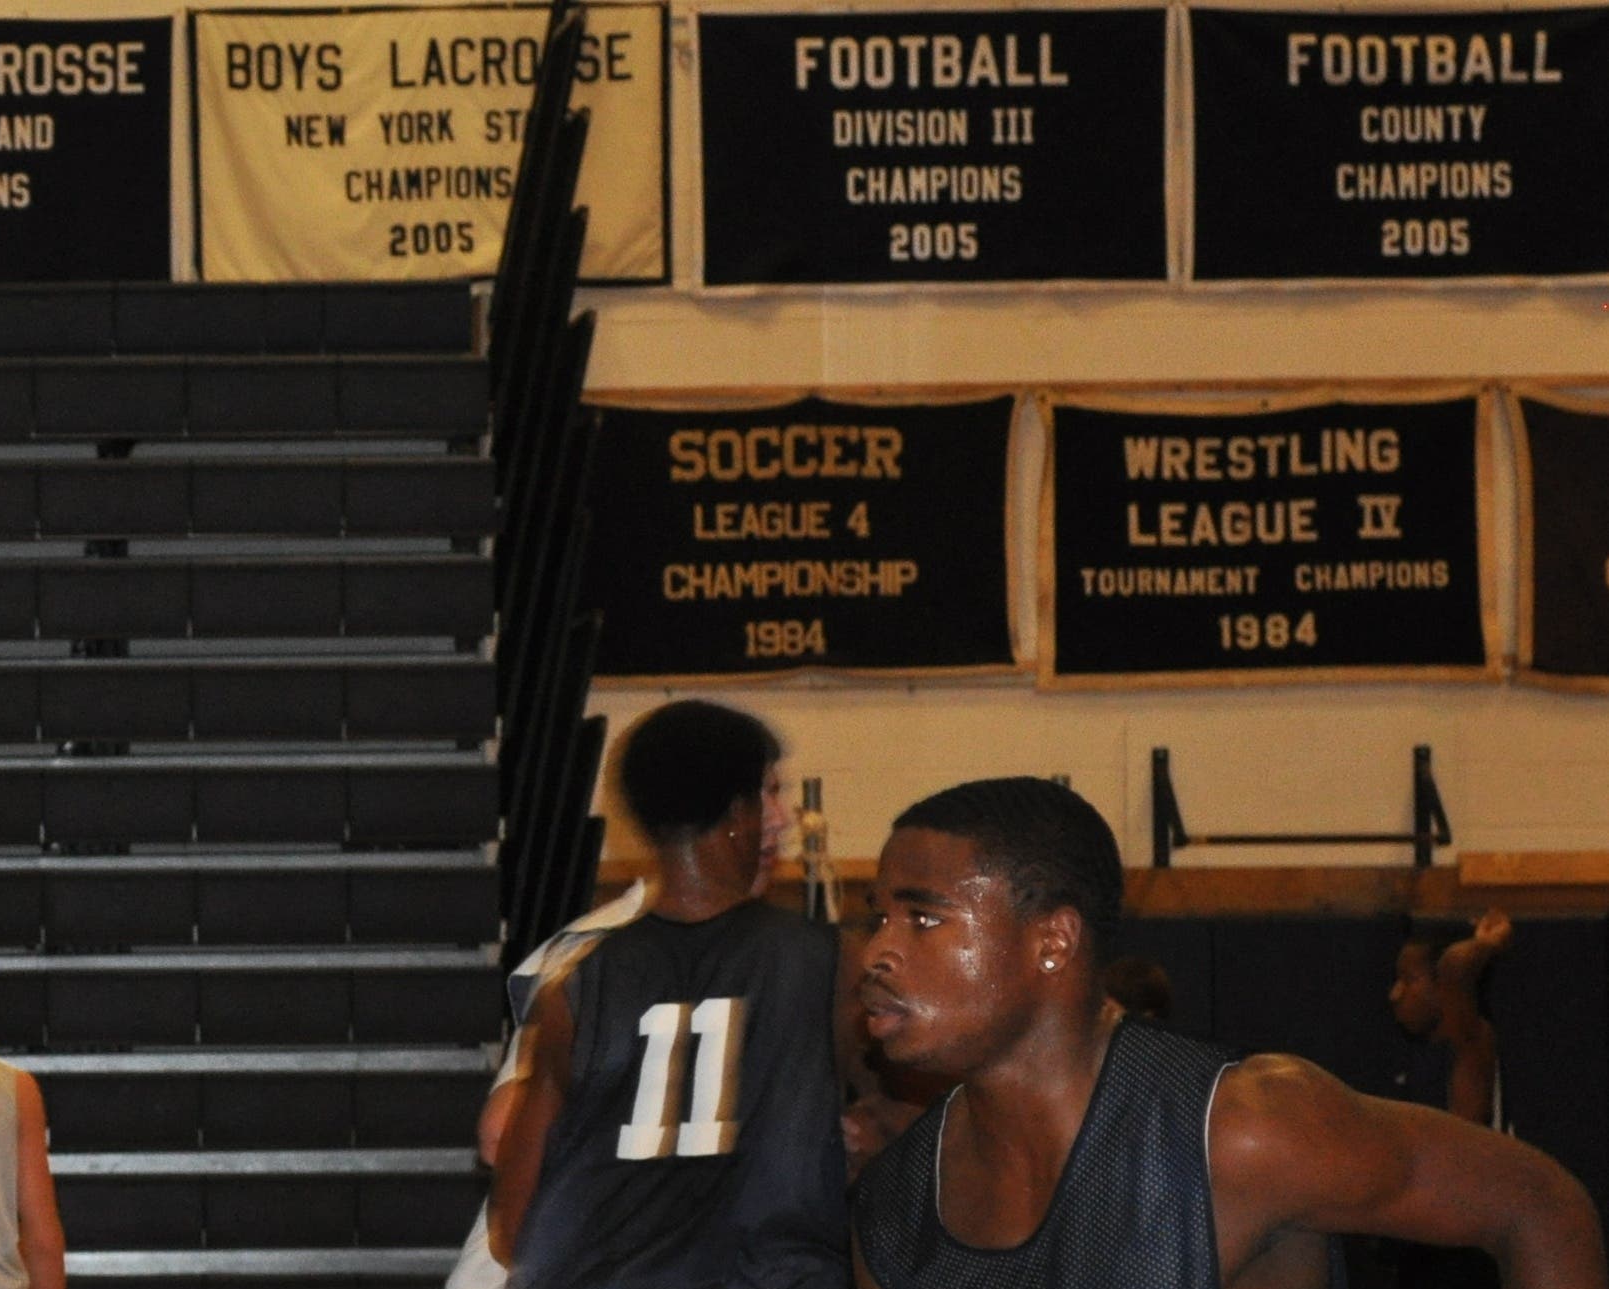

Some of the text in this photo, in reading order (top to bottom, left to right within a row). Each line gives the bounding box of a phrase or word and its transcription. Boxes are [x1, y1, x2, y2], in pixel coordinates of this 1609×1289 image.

[226, 33, 632, 92] BOYS LACROSE
[795, 33, 1069, 90] FOOTBALL
[1287, 30, 1562, 86] FOOTBALL
[285, 115, 346, 147] NEW
[379, 110, 454, 145] YORK
[833, 107, 1034, 147] DIVISION III
[1360, 105, 1486, 143] COUNTY
[345, 166, 512, 202] CHAMPIONS
[846, 165, 1022, 204] CHAMPIONS
[1336, 161, 1512, 200] CHAMPIONS
[389, 222, 475, 257] 2005
[889, 223, 978, 261] 2005
[1381, 218, 1470, 257] 2005
[668, 424, 903, 482] SOCCER
[1124, 429, 1400, 481] WRESTLING
[693, 501, 870, 540] LEAGUE 4
[1127, 494, 1402, 546] LEAGUE IV
[662, 560, 919, 600] CHAMPIONSHIP
[1080, 560, 1450, 597] TOURNAMENT CHAMPIONS
[745, 619, 826, 657] 1984
[1220, 612, 1317, 650] 1984
[616, 998, 741, 1161] 11
